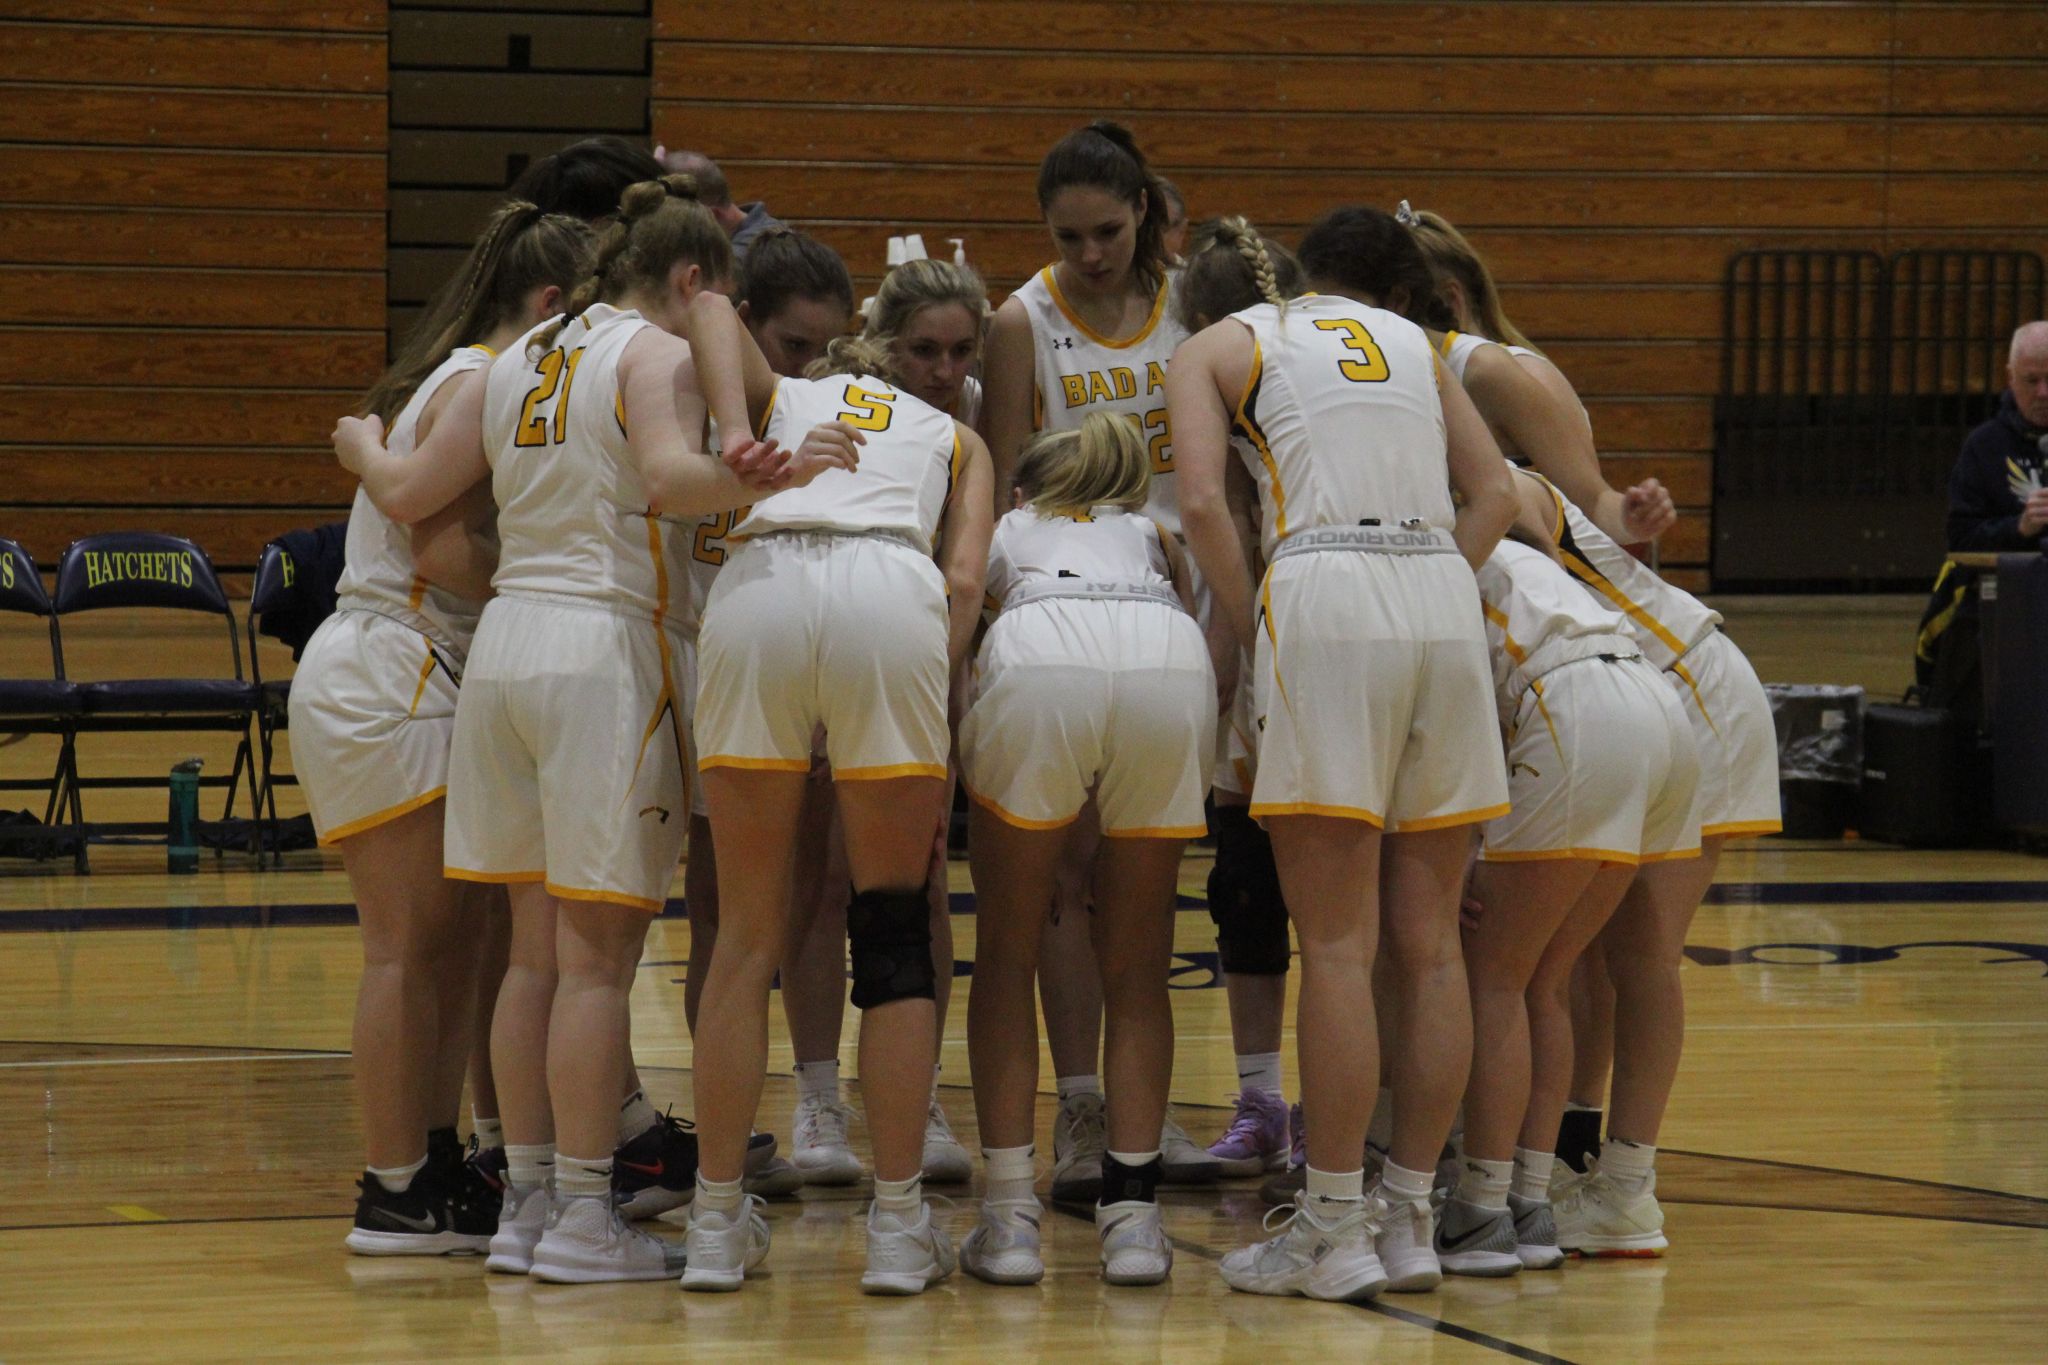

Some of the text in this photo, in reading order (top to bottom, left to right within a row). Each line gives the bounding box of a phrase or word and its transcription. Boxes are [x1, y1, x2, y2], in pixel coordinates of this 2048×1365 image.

[1312, 318, 1390, 382] 3
[514, 345, 586, 447] 21
[836, 384, 897, 432] 5
[1060, 359, 1169, 409] BAD A
[1124, 408, 1175, 475] 2
[692, 505, 752, 566] 2
[84, 551, 193, 589] HATCHETS
